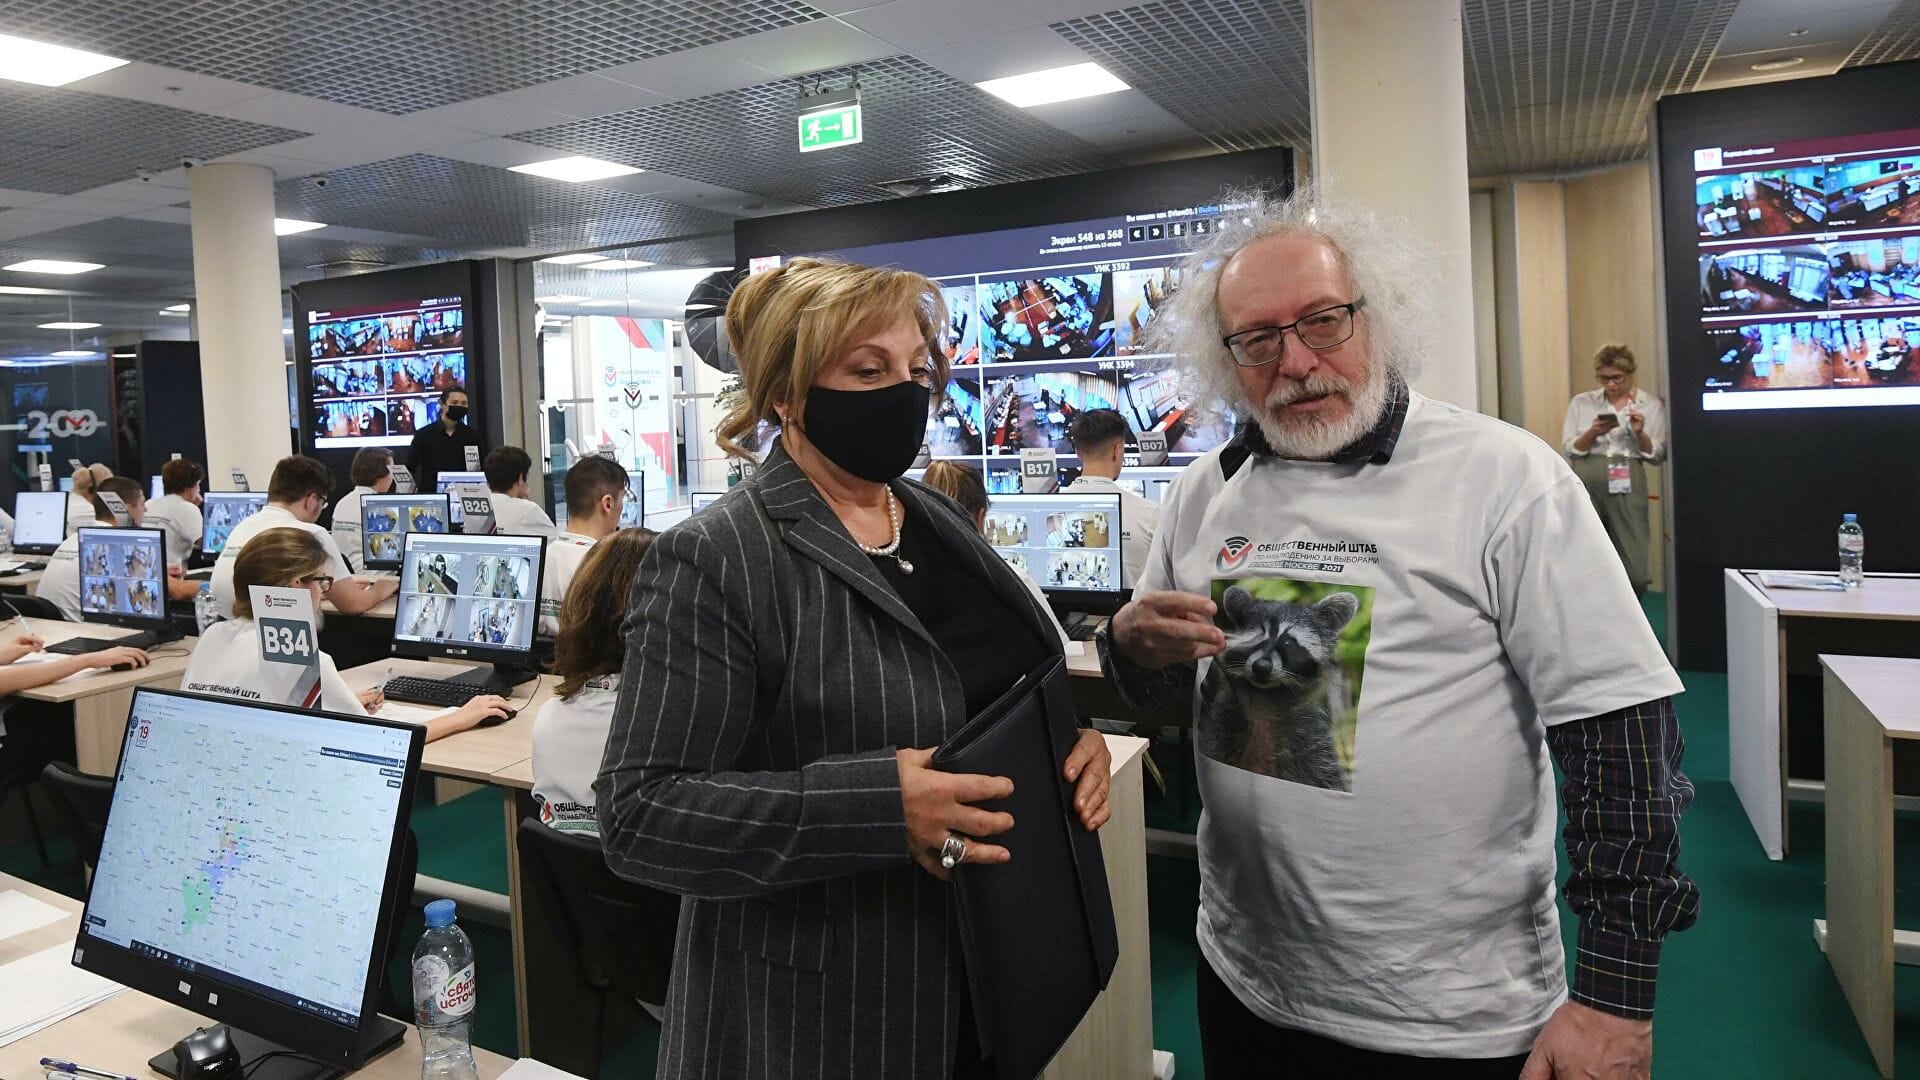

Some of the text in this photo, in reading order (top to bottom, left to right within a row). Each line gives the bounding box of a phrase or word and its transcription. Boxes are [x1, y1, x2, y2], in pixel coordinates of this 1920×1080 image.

[1051, 229, 1123, 246] Экран 548 из 568
[1112, 262, 1130, 271] 3392
[1098, 360, 1135, 369] УИК 3394
[1142, 442, 1163, 450] B07
[1026, 464, 1050, 474] B17
[464, 500, 490, 513] B26
[1257, 540, 1378, 553] ОБЩЕСТВЕННЫЙ ШТАБ
[1333, 556, 1380, 564] ВЫБОРАМИ
[1284, 561, 1320, 570] МОСКВЕ
[1322, 564, 1342, 573] 2021
[263, 626, 310, 656] B34
[139, 725, 149, 739] 19
